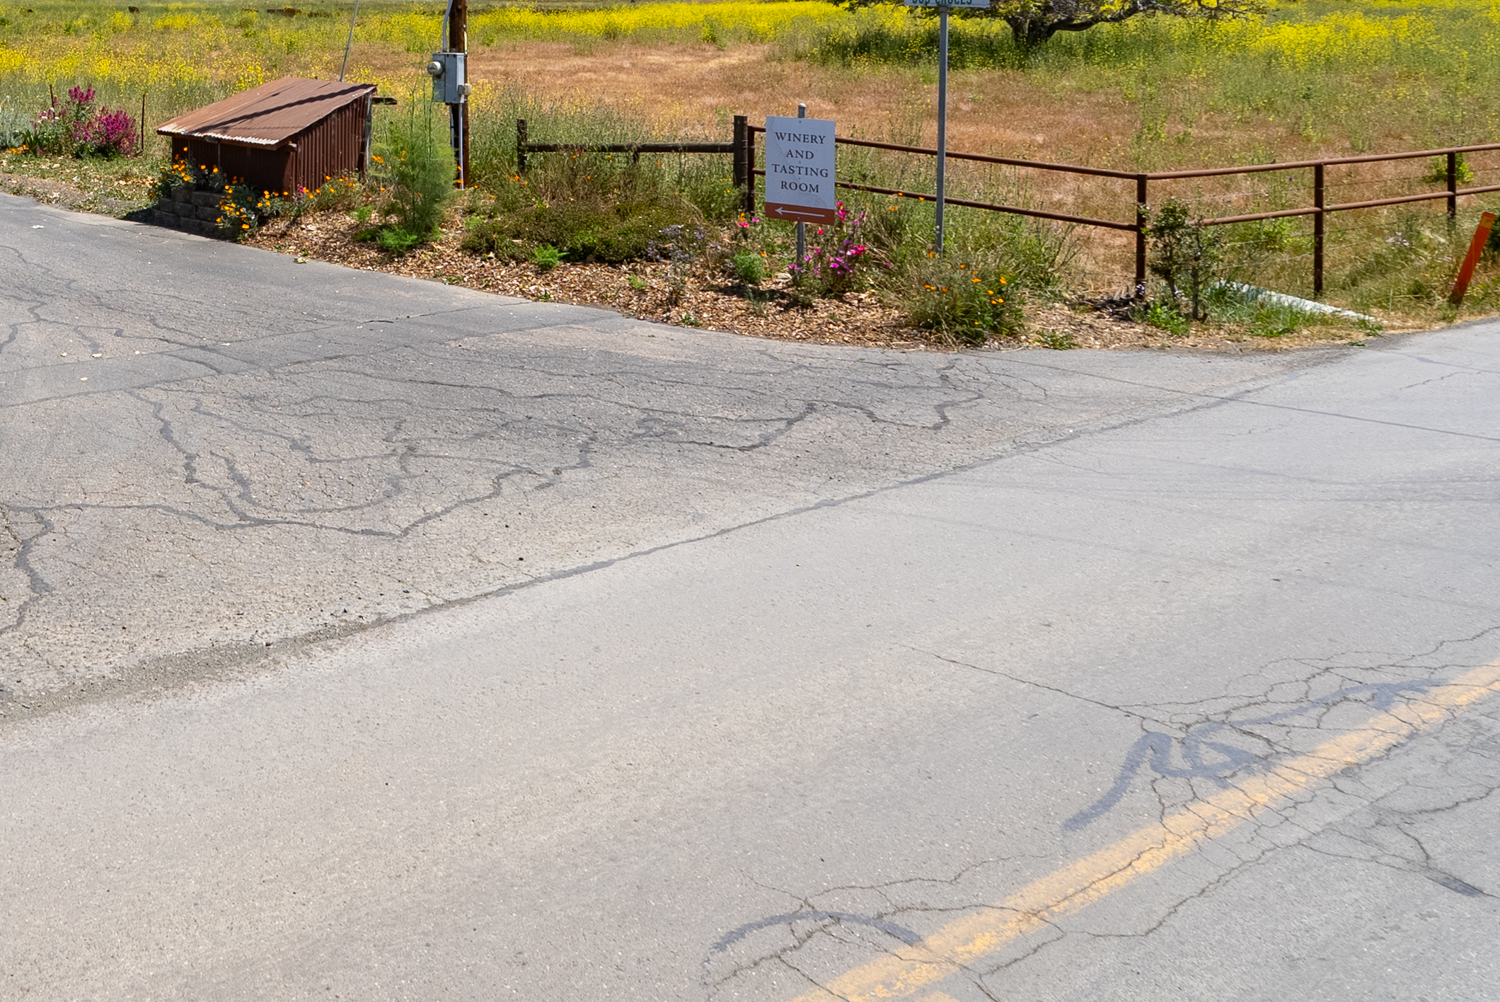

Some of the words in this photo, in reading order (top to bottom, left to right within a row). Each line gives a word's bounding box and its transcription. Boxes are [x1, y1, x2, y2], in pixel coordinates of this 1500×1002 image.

[775, 131, 827, 145] WINERY
[785, 149, 815, 160] AND
[771, 163, 829, 178] TASTING
[780, 180, 820, 193] ROOM
